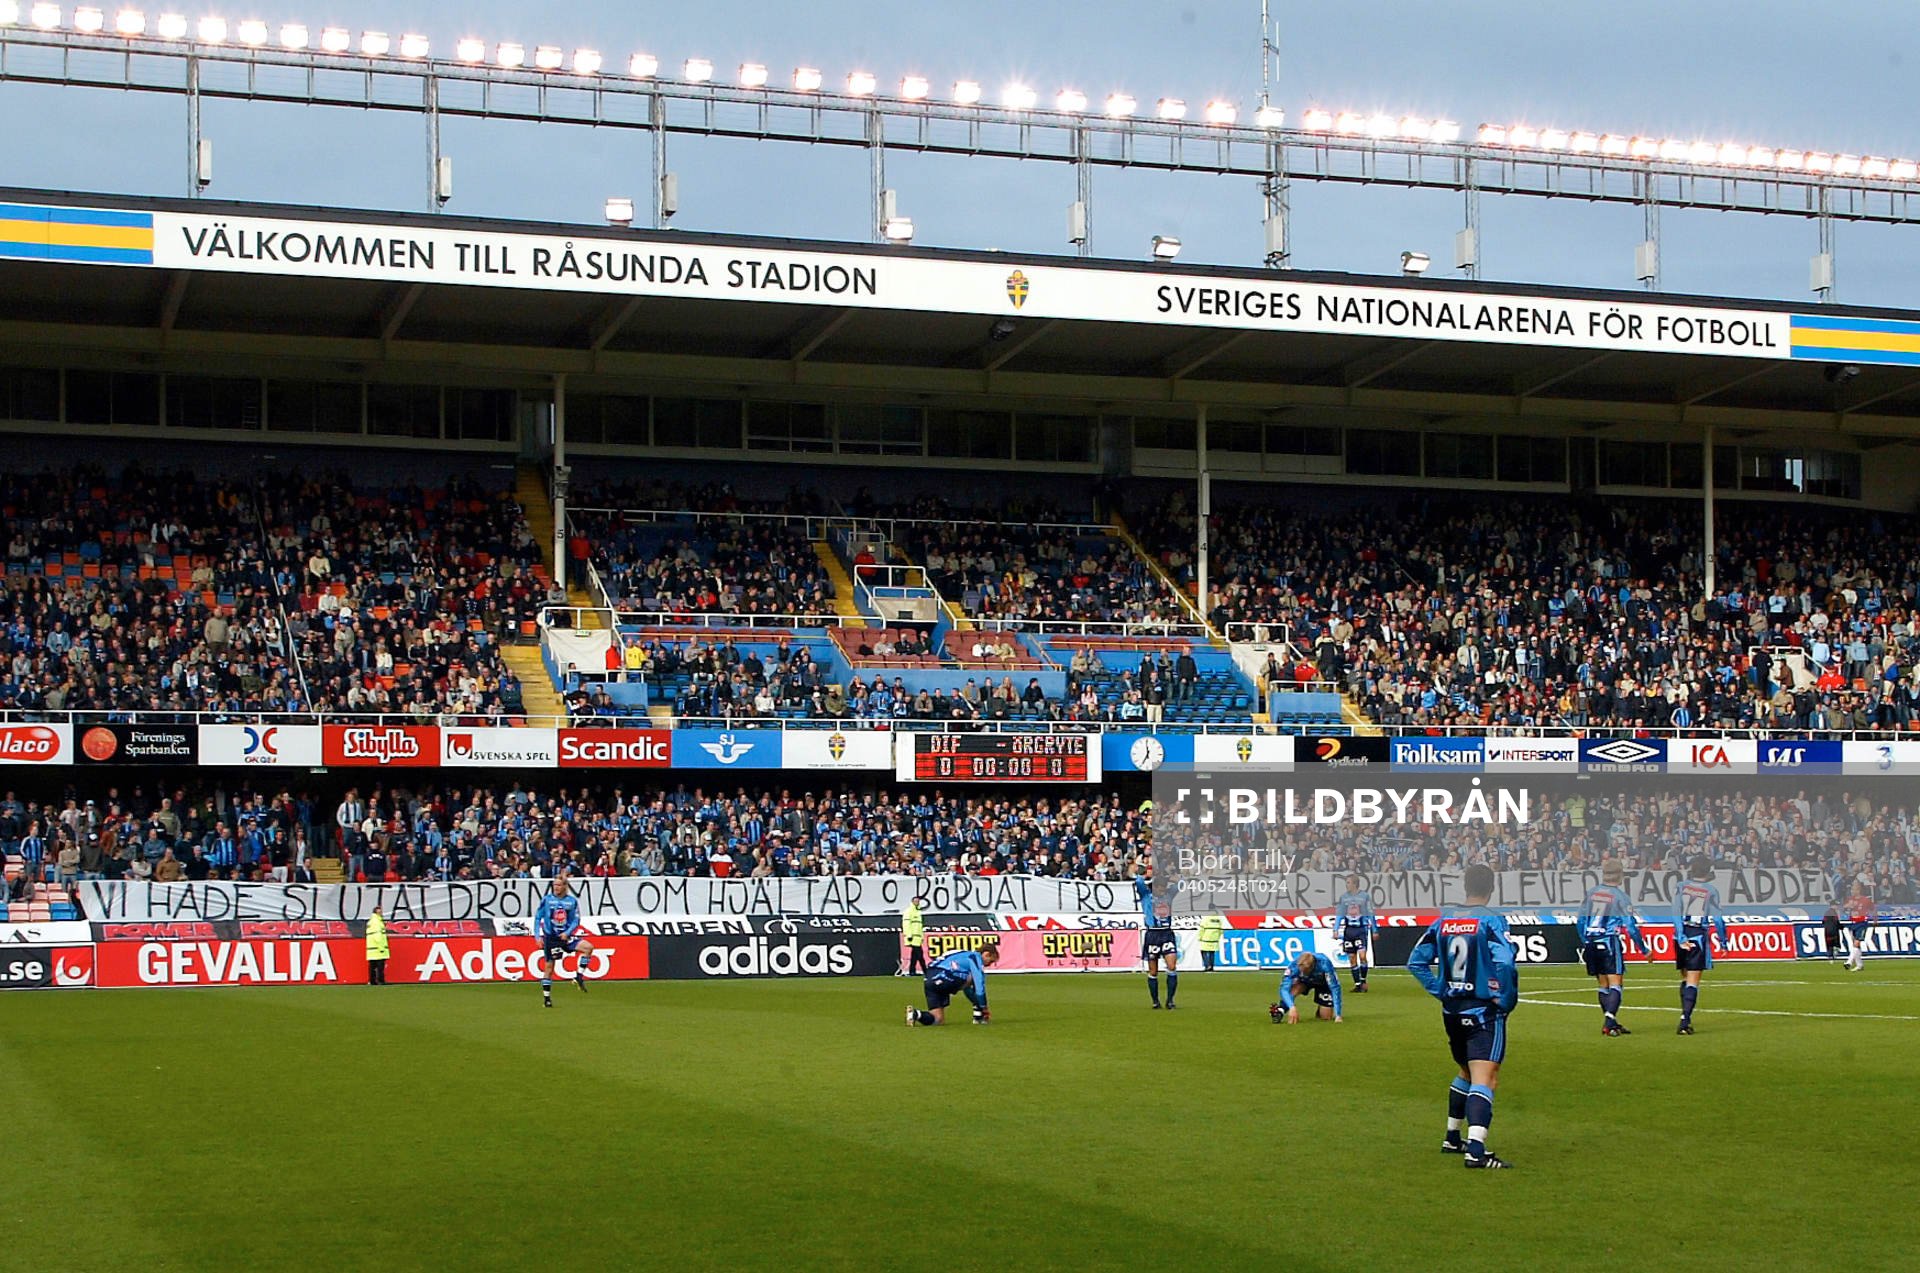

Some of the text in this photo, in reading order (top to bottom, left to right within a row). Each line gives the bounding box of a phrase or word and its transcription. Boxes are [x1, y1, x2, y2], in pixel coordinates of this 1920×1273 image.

[182, 223, 876, 295] VÄLKOMMEN TILL RÅSUNDA STADION
[1157, 286, 1776, 347] SVERIGES NATIONALARENA FÖR FOTBOLL
[0, 732, 50, 753] laco
[125, 743, 190, 757] Sparbanken
[344, 729, 418, 763] Sibylla
[562, 736, 667, 760] Scandic
[719, 734, 735, 745] SJ
[930, 735, 961, 753] DIF
[474, 751, 551, 760] SVENSKA SPEL
[1394, 743, 1481, 766] Folksam
[1502, 750, 1575, 761] INTERSPORT
[1692, 745, 1731, 768] ICA
[1763, 748, 1806, 767] SAS
[92, 882, 126, 919] VI
[147, 882, 263, 920] HADE
[637, 879, 690, 915] OM
[1728, 869, 1833, 904] ADDE!
[104, 922, 217, 940] POWER
[240, 921, 352, 939] POWER
[699, 937, 853, 975] adidas
[1043, 932, 1113, 957] SPORT
[1219, 934, 1303, 965] tre.se
[137, 942, 337, 983] GEVALIA
[1448, 936, 1468, 982] 2
